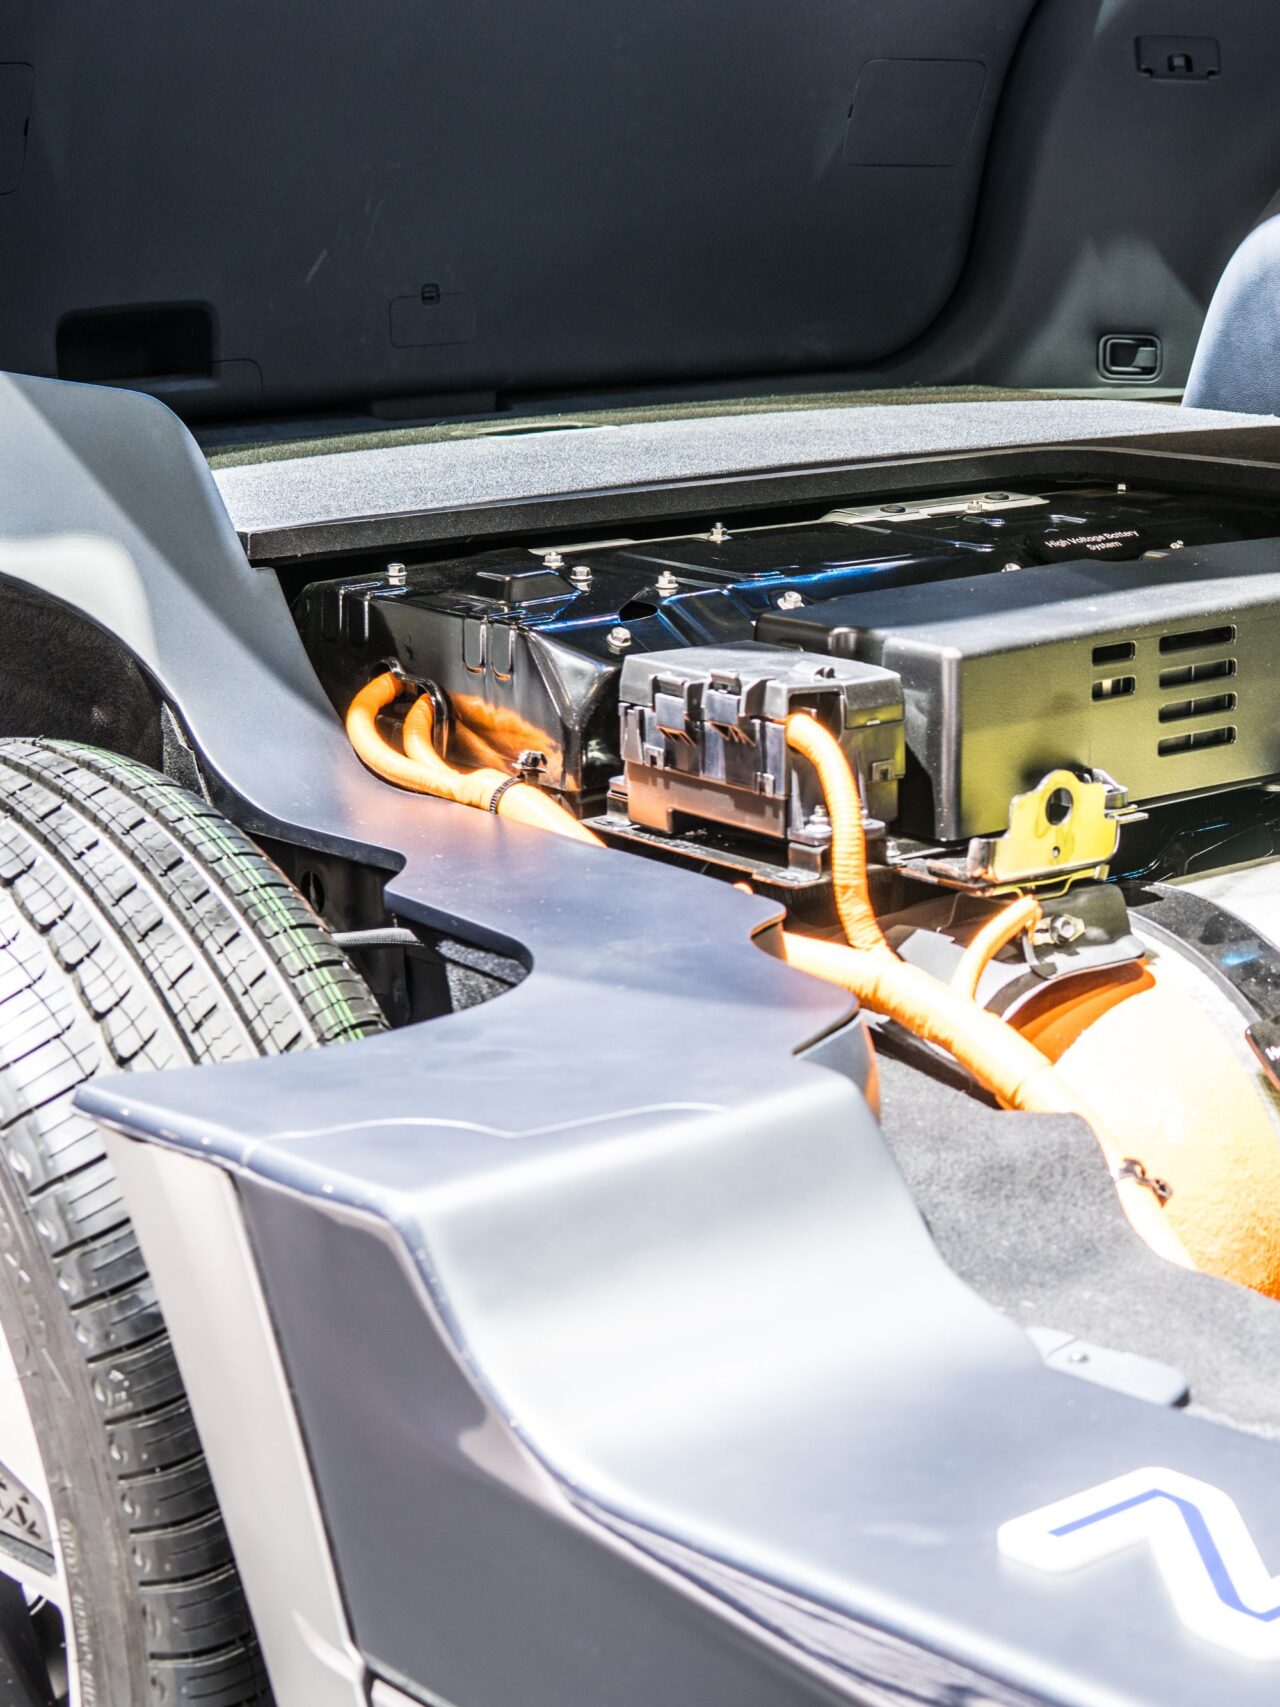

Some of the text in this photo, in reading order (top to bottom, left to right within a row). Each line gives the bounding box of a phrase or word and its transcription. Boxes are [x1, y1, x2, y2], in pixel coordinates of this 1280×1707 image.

[1045, 529, 1139, 550] High Voltage Battery
[1086, 540, 1123, 552] System
